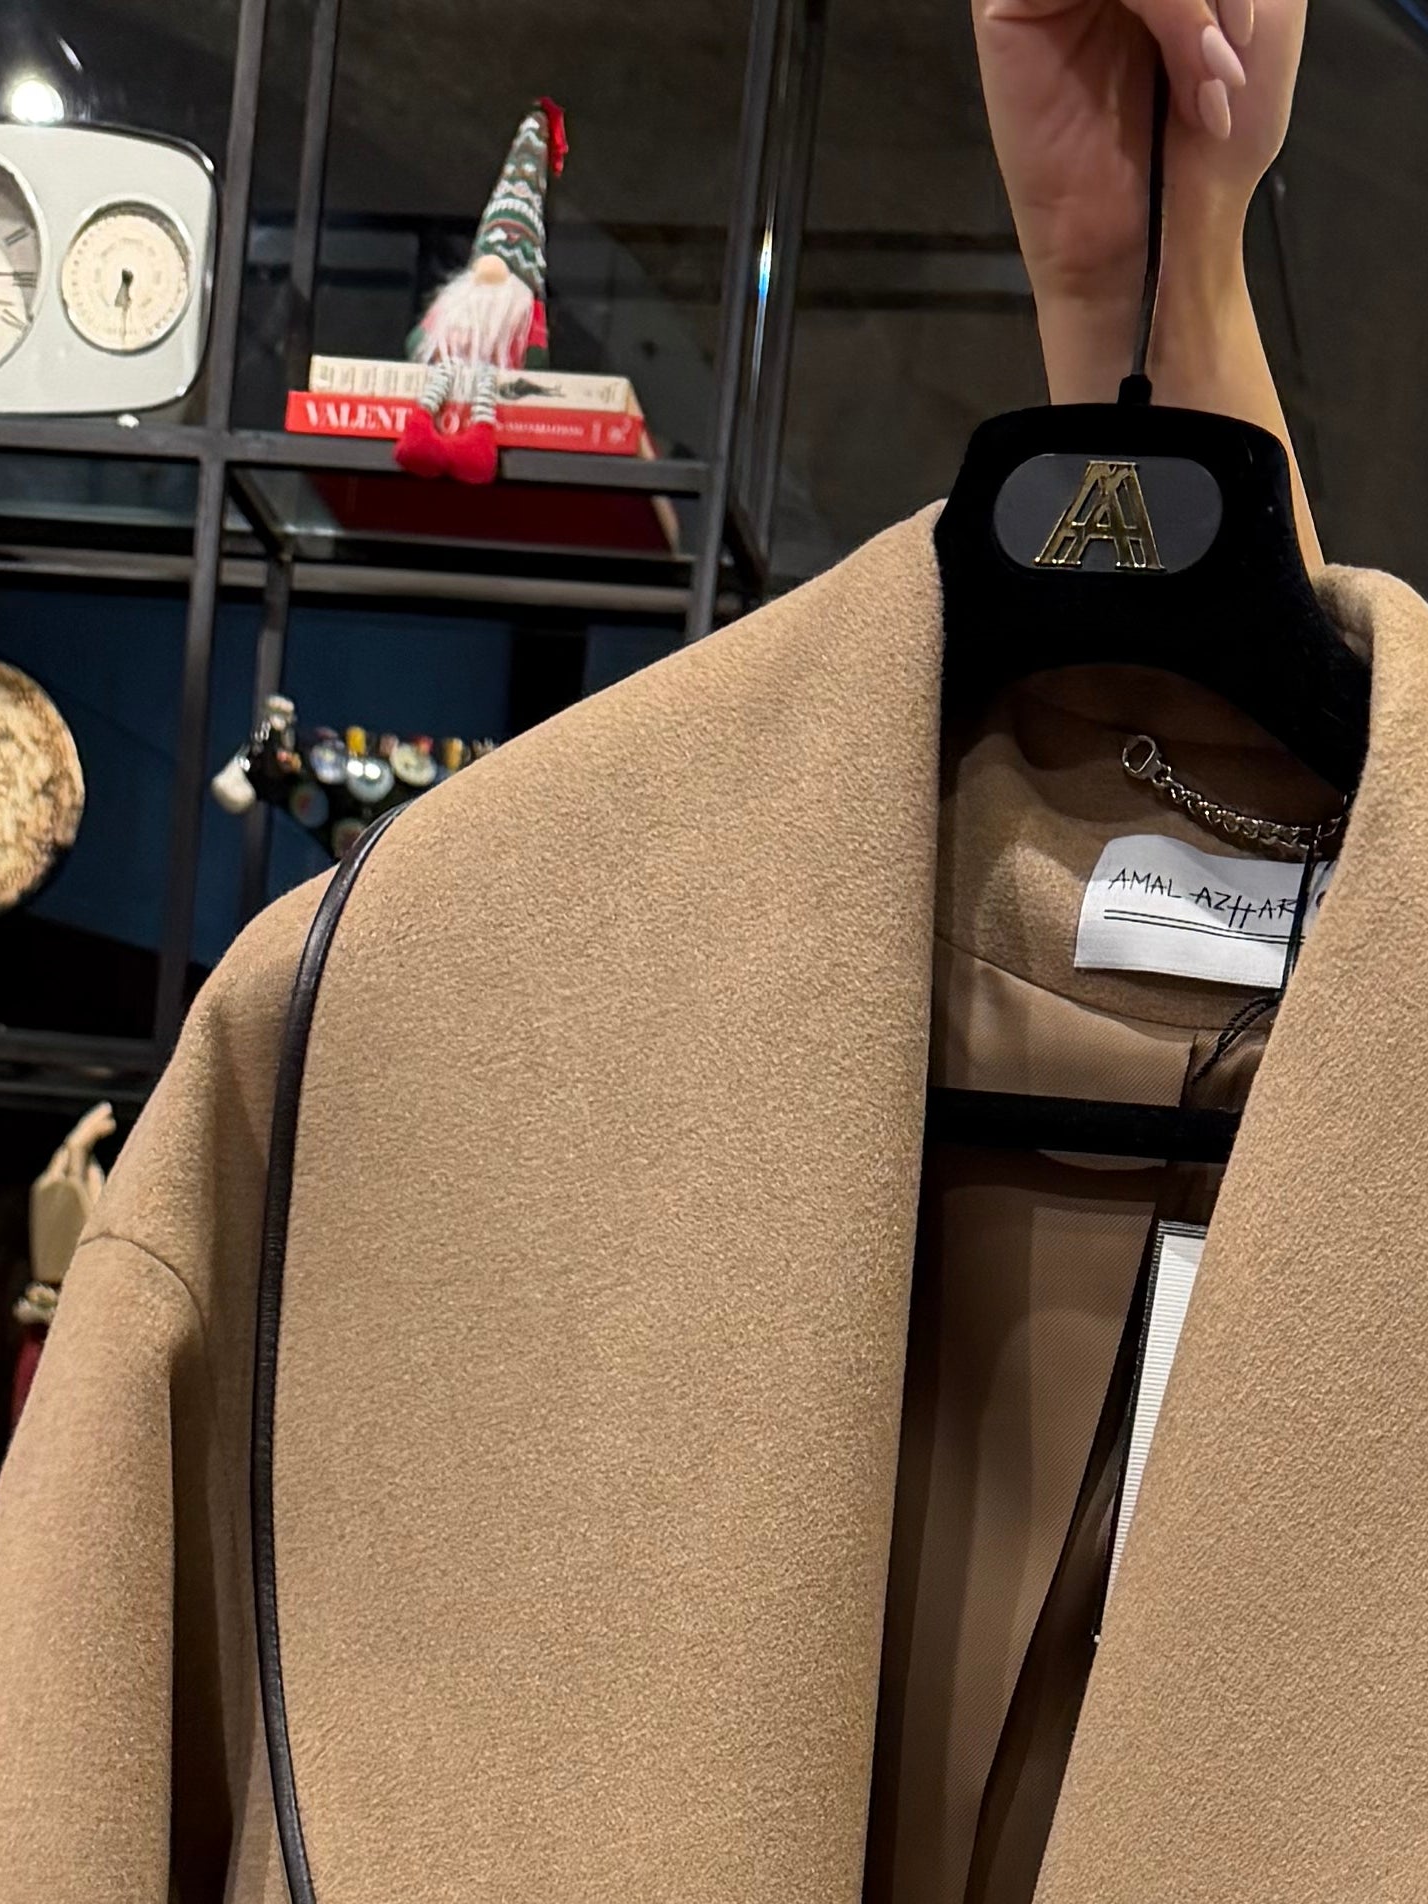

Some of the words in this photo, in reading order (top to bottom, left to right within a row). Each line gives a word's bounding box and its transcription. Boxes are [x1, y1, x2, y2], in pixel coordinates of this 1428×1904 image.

[305, 400, 461, 435] VALENTO
[1108, 868, 1182, 898] AMAL
[1189, 886, 1298, 929] AZHAR
